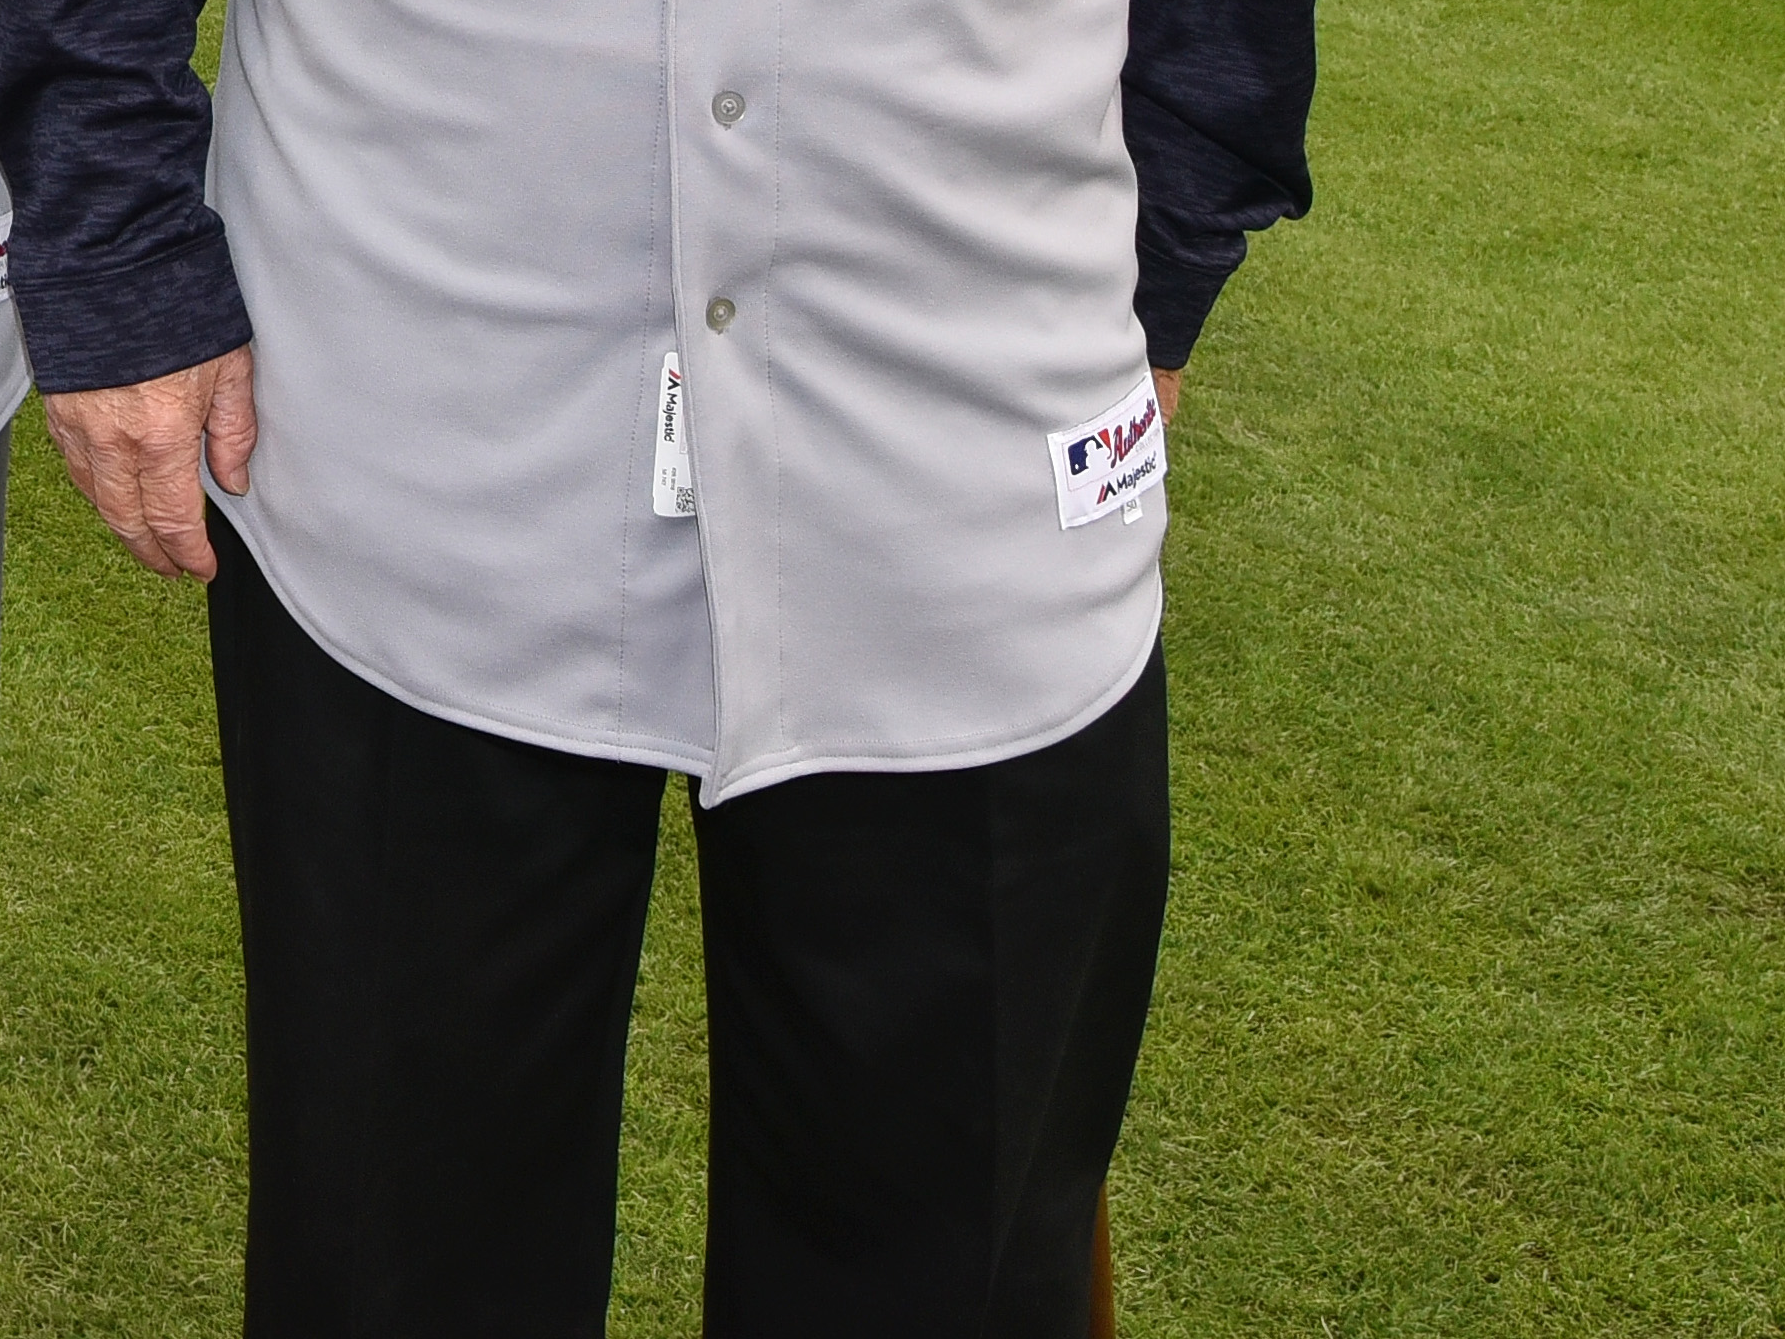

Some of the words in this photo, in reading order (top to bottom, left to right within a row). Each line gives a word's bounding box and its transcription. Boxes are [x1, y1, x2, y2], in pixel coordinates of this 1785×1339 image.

[662, 392, 678, 443] Majestic
[1110, 398, 1157, 469] Authentic
[1117, 452, 1157, 494] Majestic
[1126, 499, 1138, 512] 50
